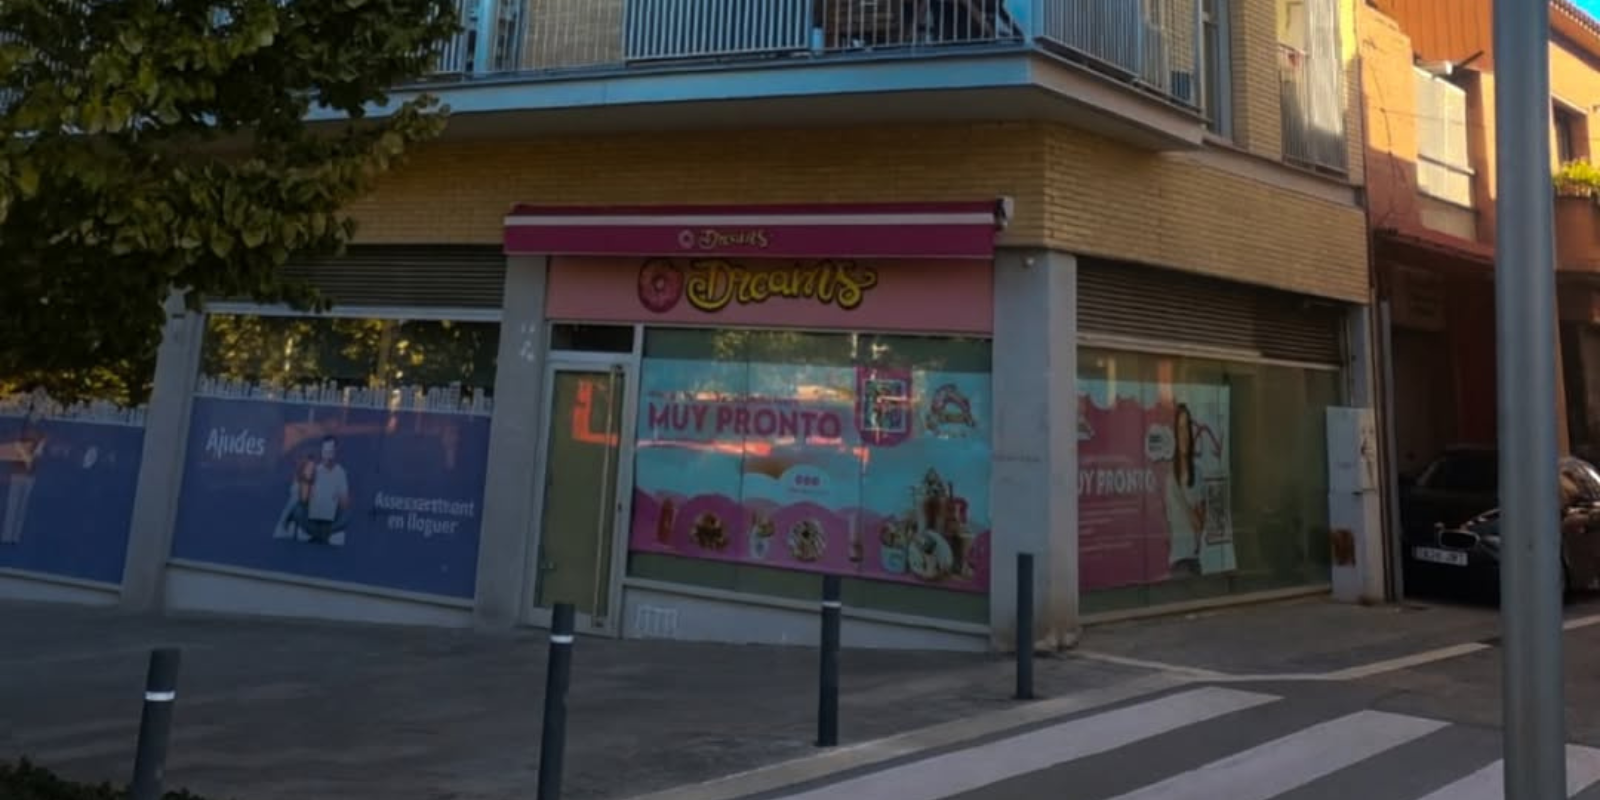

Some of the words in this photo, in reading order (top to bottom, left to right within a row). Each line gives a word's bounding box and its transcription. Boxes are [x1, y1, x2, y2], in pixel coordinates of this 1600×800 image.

[687, 258, 878, 311] Dreams
[649, 402, 707, 431] MUY
[716, 406, 842, 440] PRONTO
[205, 426, 266, 461] Ajudes
[1096, 467, 1156, 495] PRONTO
[408, 512, 460, 538] lloguer
